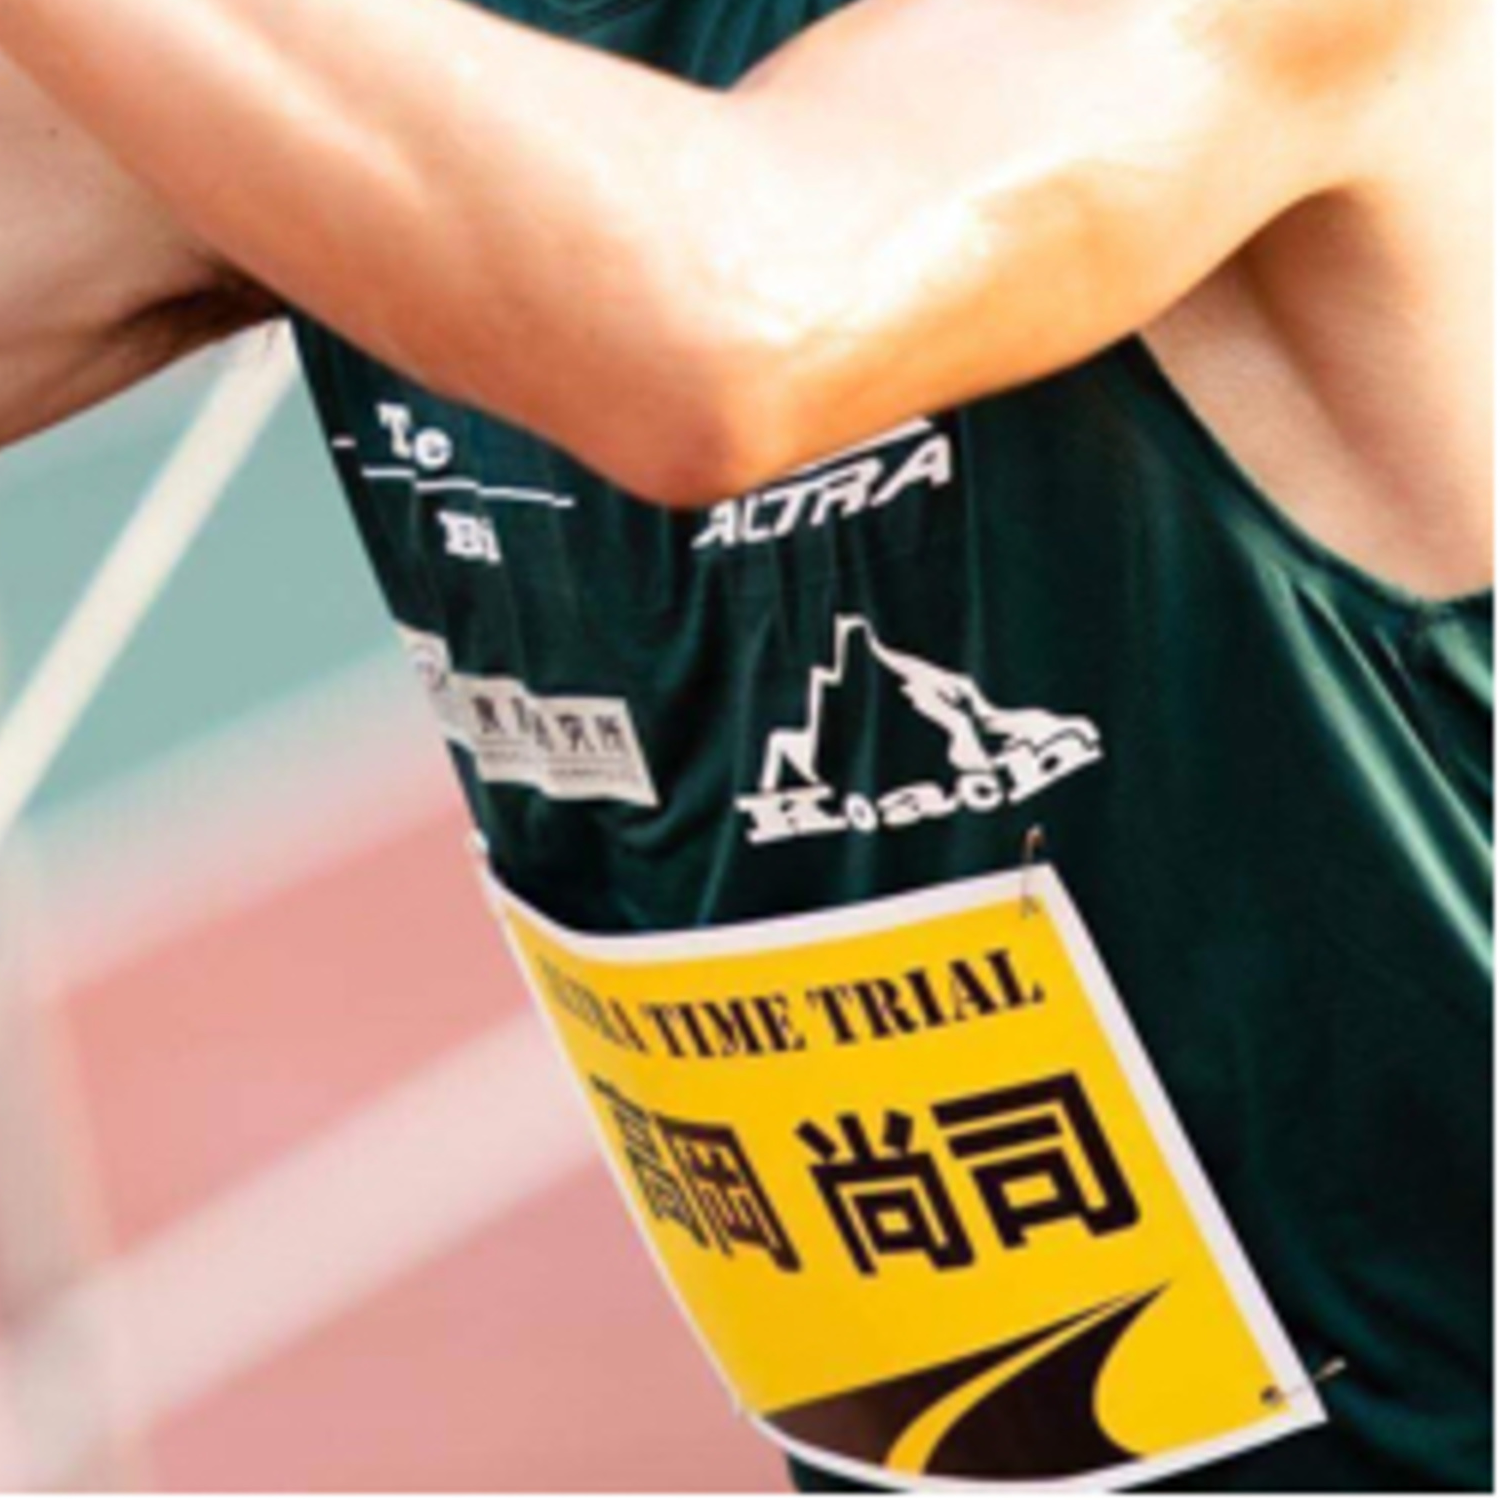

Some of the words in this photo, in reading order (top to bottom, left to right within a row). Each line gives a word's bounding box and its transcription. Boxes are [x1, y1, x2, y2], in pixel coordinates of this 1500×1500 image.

[690, 433, 952, 550] ALTRA
[734, 729, 1104, 846] Koach
[645, 994, 807, 1060] TIME
[805, 947, 1046, 1046] TRIAL
[793, 1069, 1142, 1278] 尚司
